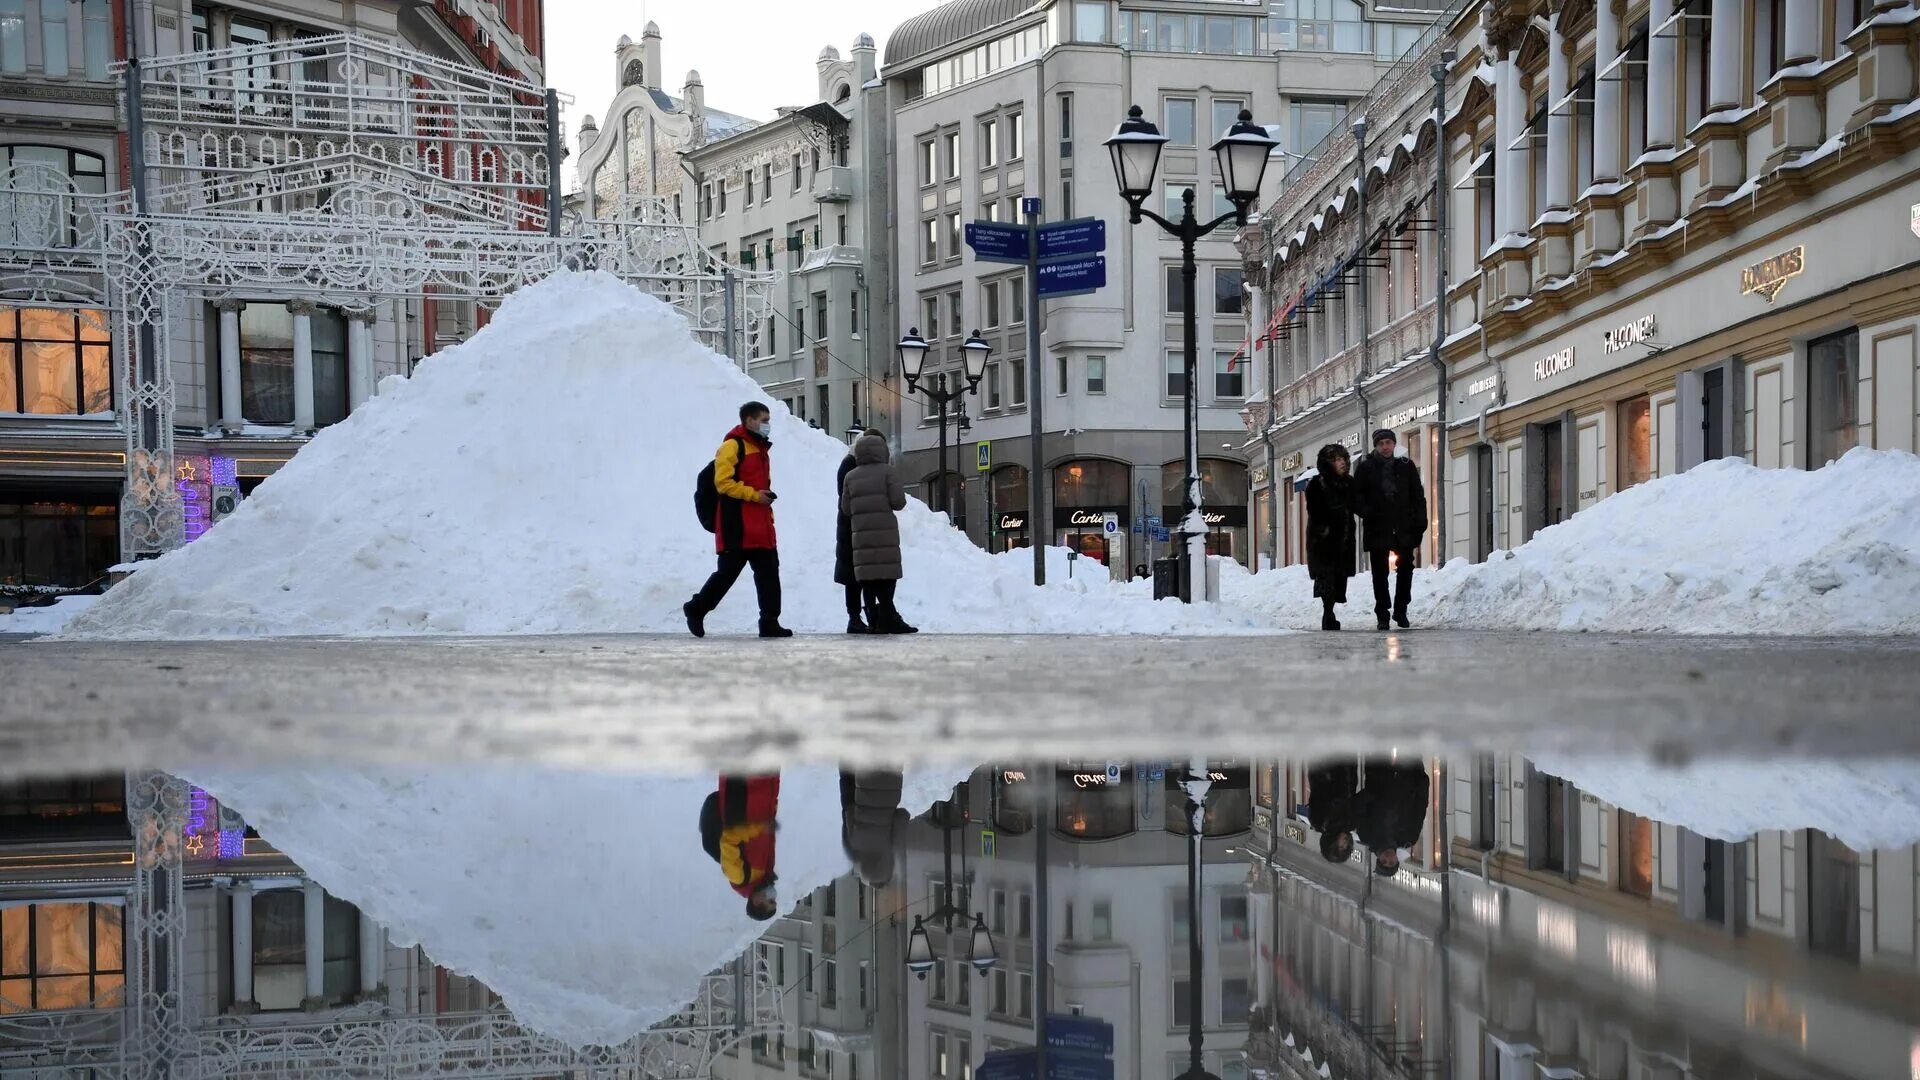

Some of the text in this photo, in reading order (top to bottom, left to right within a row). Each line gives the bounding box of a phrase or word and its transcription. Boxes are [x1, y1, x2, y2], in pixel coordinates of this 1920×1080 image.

[1057, 262, 1082, 273] Кузнецкий
[1083, 261, 1096, 269] Мост
[1740, 245, 1804, 295] LONGINES
[1534, 346, 1575, 381] FALCONERI
[1001, 515, 1023, 529] Cartier
[1070, 510, 1104, 524] Cartie
[1204, 512, 1226, 523] tier
